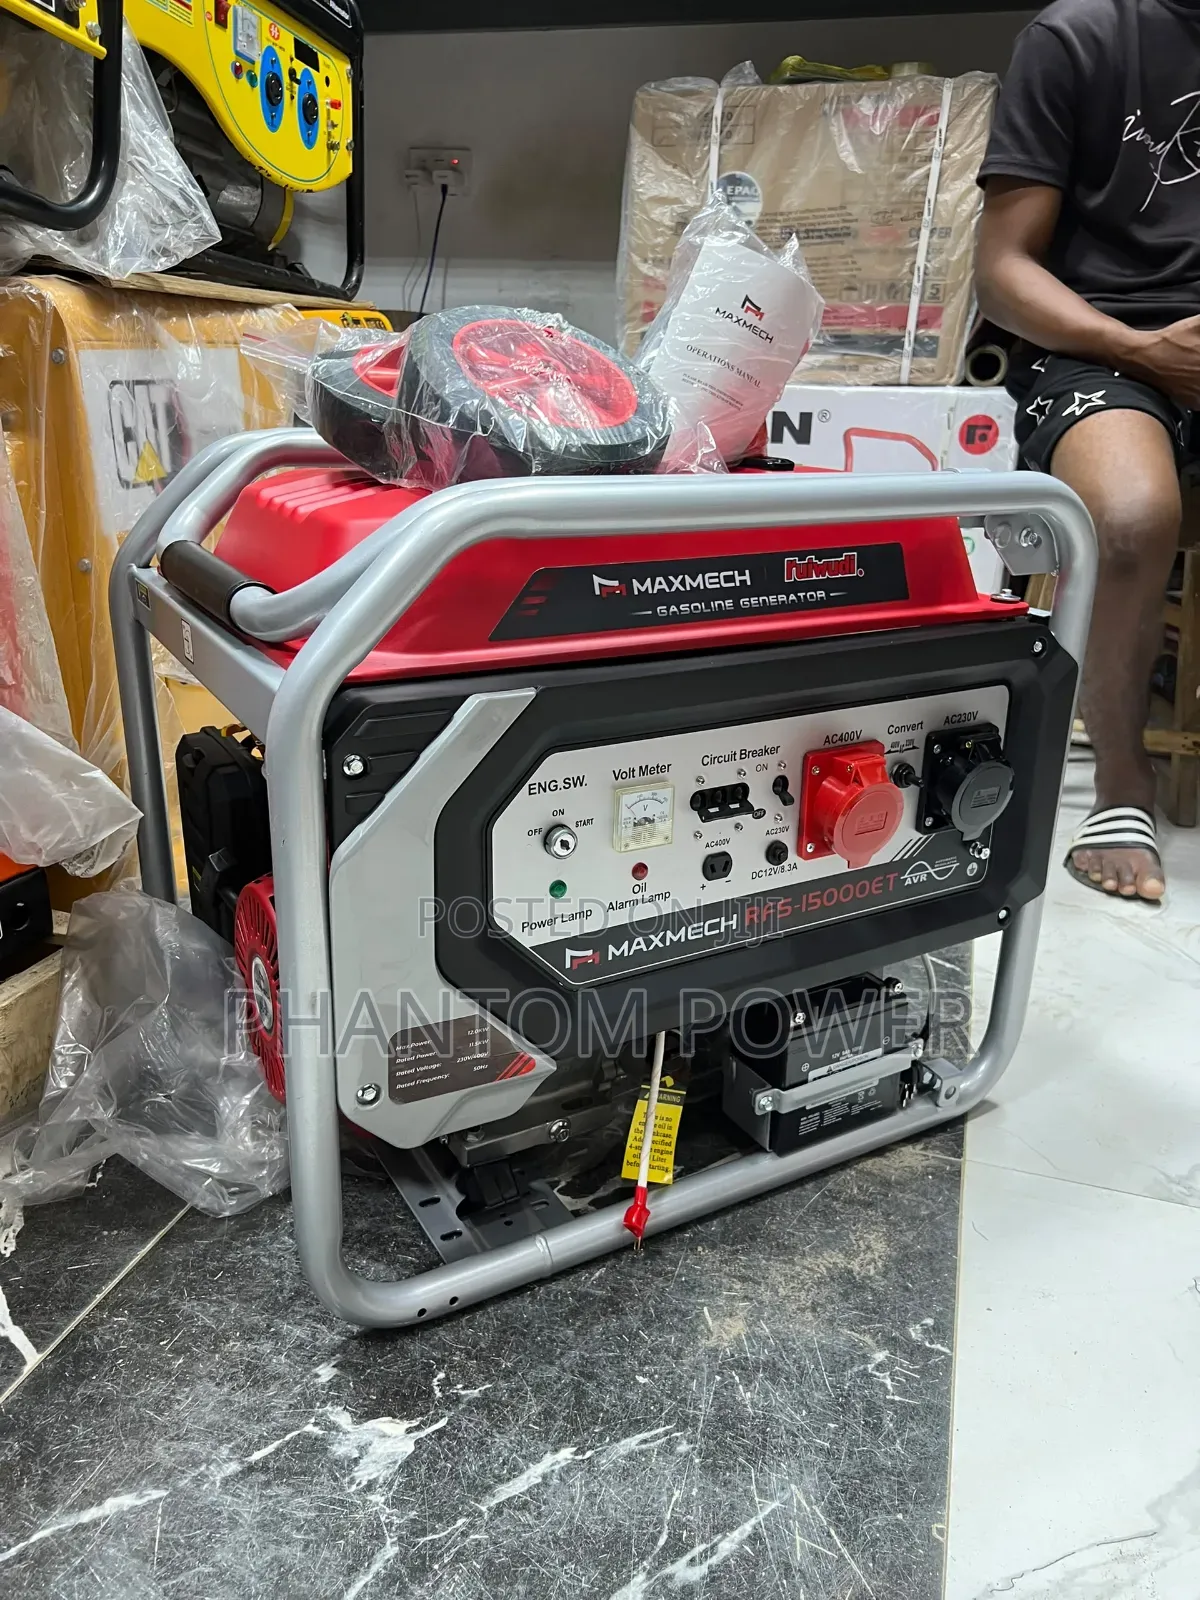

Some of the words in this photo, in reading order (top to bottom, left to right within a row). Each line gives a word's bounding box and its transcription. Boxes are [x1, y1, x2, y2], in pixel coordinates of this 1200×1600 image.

[909, 227, 952, 239] CPER
[715, 307, 774, 344] MAXMECH
[686, 344, 735, 372] OPERATIONS
[736, 367, 761, 388] MANUAL
[632, 569, 751, 595] MAXMECH
[657, 600, 734, 617] GASOLINE
[740, 591, 827, 609] GENERATOR
[943, 711, 979, 726] AC230V
[887, 720, 924, 735] Convert
[823, 730, 863, 746] AC400V
[701, 750, 737, 767] Circuit
[739, 744, 781, 761] Breaker
[612, 767, 636, 781] Volt
[638, 763, 672, 778] Meter
[755, 763, 769, 772] ON
[528, 775, 588, 796] ENG.SW.
[552, 808, 565, 817] ON
[752, 810, 766, 818] OFF
[575, 818, 594, 828] START
[527, 828, 543, 837] OFF
[765, 825, 790, 836] AC230V
[705, 838, 731, 849] AC400V
[751, 862, 798, 880] DC12V/8.3A
[904, 873, 927, 886] AVR
[632, 882, 647, 895] Oil
[606, 895, 639, 912] Alarm
[641, 890, 671, 906] Lamp
[521, 917, 559, 932] Power
[561, 908, 593, 924] Lamp
[607, 914, 738, 961] MAXMECH
[396, 1055, 415, 1064] Rated
[416, 1051, 438, 1060] Power:
[396, 1067, 415, 1077] Rated
[416, 1062, 442, 1073] Voltage:
[396, 1080, 416, 1089] Rated
[416, 1073, 450, 1085] Frequency:
[473, 1064, 488, 1072] 50Hz
[658, 1093, 681, 1103] ARNING
[634, 1127, 643, 1135] the
[652, 1139, 672, 1147] ecified
[652, 1155, 667, 1163] Liter
[626, 1160, 640, 1168] befo
[649, 1164, 671, 1173] tarting.
